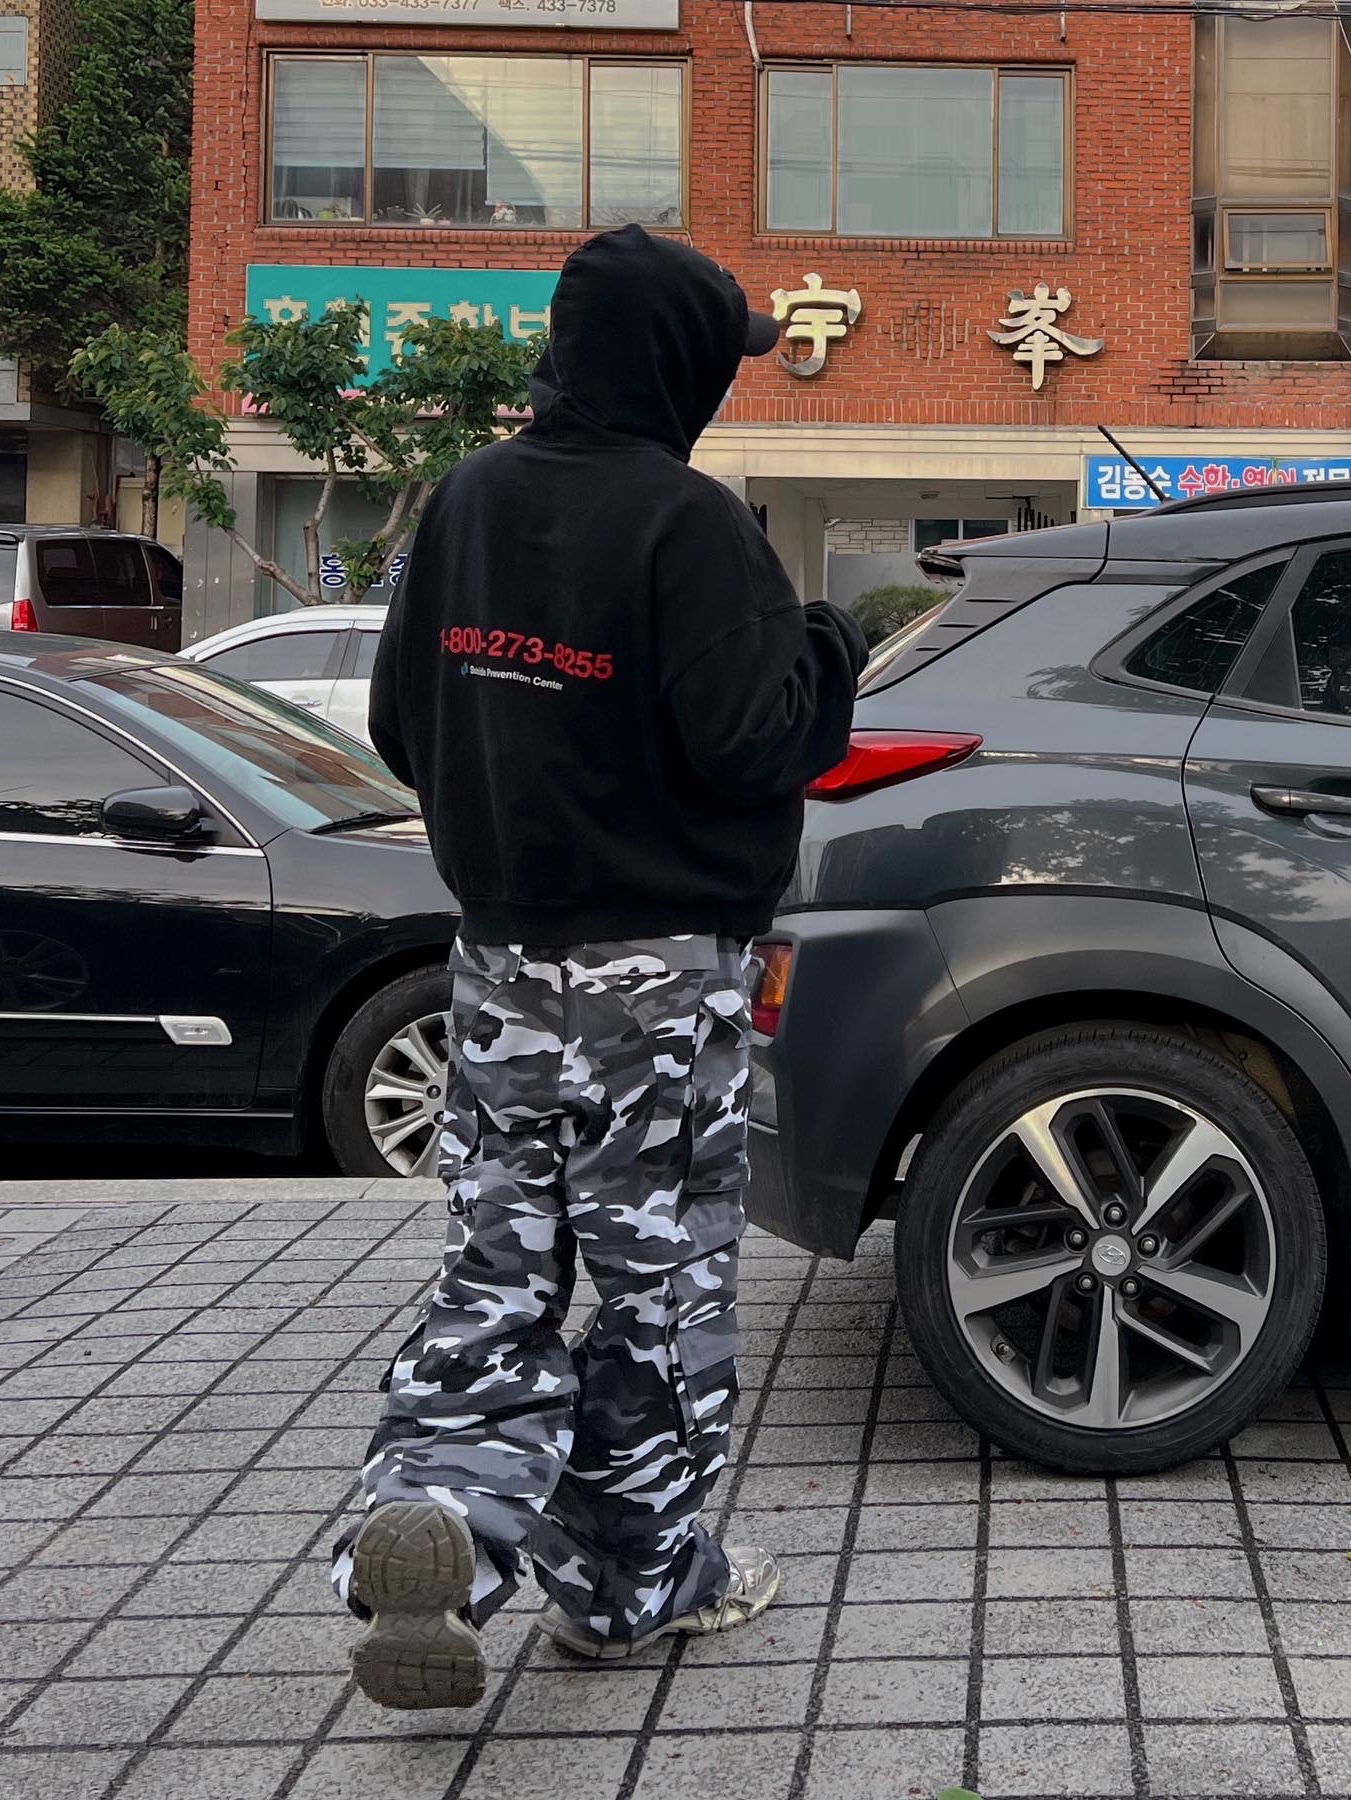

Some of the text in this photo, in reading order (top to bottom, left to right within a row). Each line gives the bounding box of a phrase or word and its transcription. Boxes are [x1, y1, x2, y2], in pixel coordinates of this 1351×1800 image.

[537, 0, 616, 13] 433-7378
[440, 626, 613, 680] 1-800-273-8255
[532, 676, 563, 691] Center
